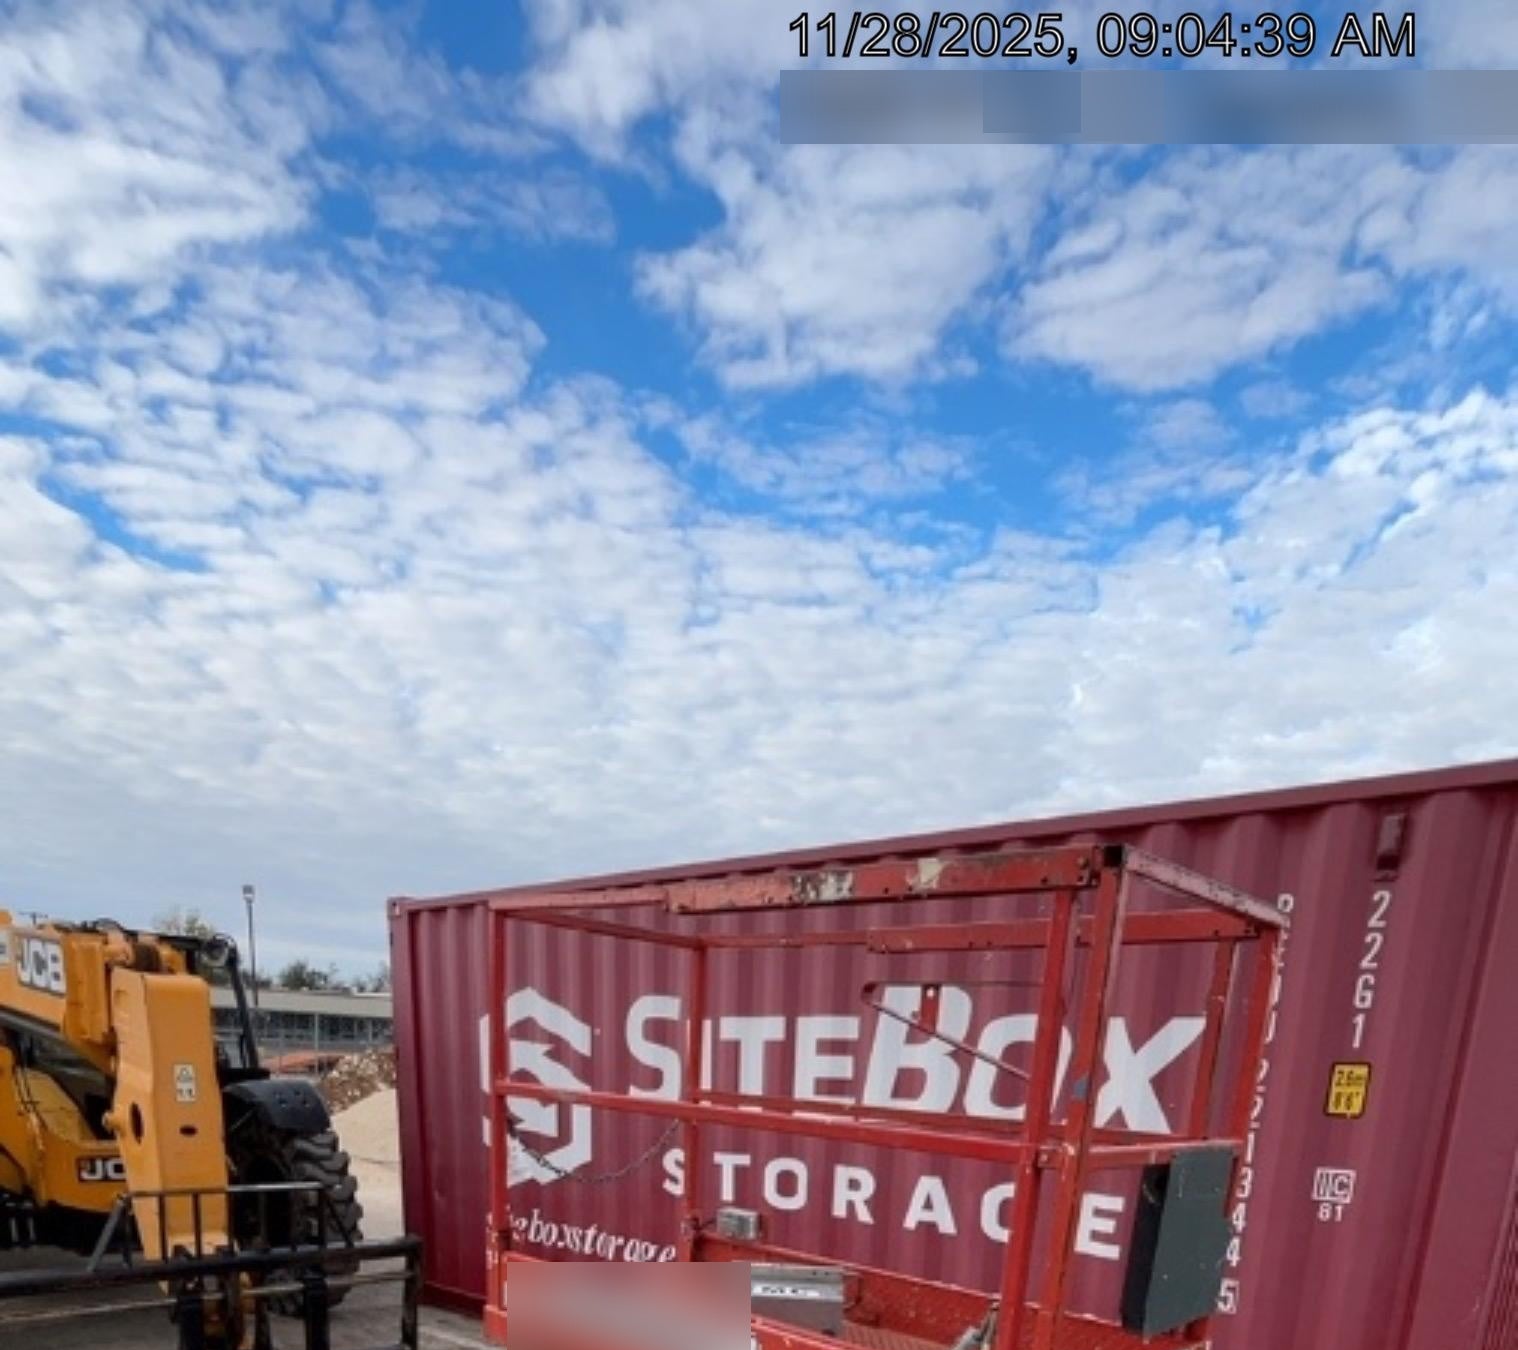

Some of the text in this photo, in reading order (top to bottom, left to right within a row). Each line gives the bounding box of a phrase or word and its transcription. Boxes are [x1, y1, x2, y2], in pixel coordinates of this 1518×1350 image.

[19, 938, 66, 994] JCB
[79, 1156, 127, 1182] JC
[661, 1147, 1125, 1260] STORAGE
